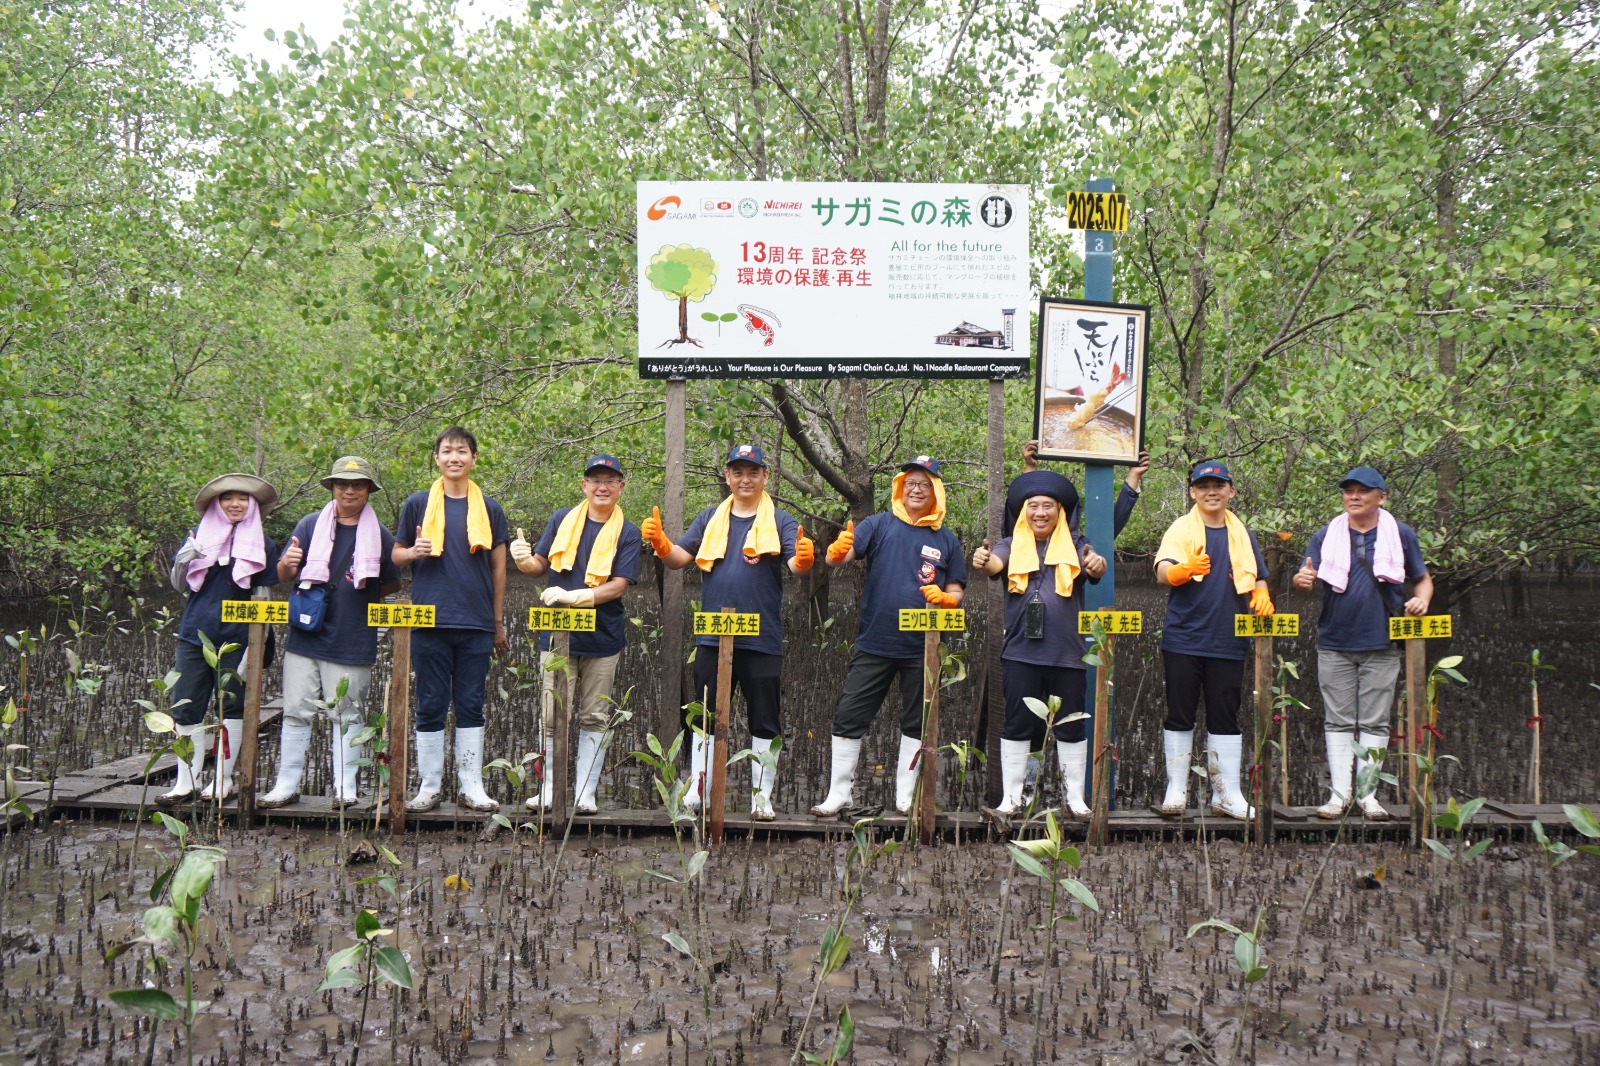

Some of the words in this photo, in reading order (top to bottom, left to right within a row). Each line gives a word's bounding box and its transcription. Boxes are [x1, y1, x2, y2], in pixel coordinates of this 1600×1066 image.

[763, 199, 803, 211] NICHIREI
[811, 196, 973, 228] サガミの森
[1068, 192, 1127, 230] 2025.07
[666, 212, 697, 220] SAGAMI
[891, 240, 908, 251] All
[913, 240, 932, 251] for
[937, 240, 957, 251] the
[963, 240, 1002, 251] future
[1094, 237, 1104, 252] 3
[740, 241, 804, 265] 13周年
[812, 246, 867, 266] 記念祭
[1076, 318, 1110, 382] 天ぷら
[647, 364, 722, 372] 「ありがとう」がうれしい
[728, 364, 743, 372] Your
[744, 364, 772, 372] Pleasure
[773, 364, 779, 372] is
[780, 364, 794, 372] Our
[795, 364, 823, 372] Pleasure
[828, 364, 836, 373] By
[837, 364, 862, 373] Sagami
[863, 364, 883, 372] Chain
[954, 364, 989, 372] Restaurant
[989, 364, 1022, 373] Company
